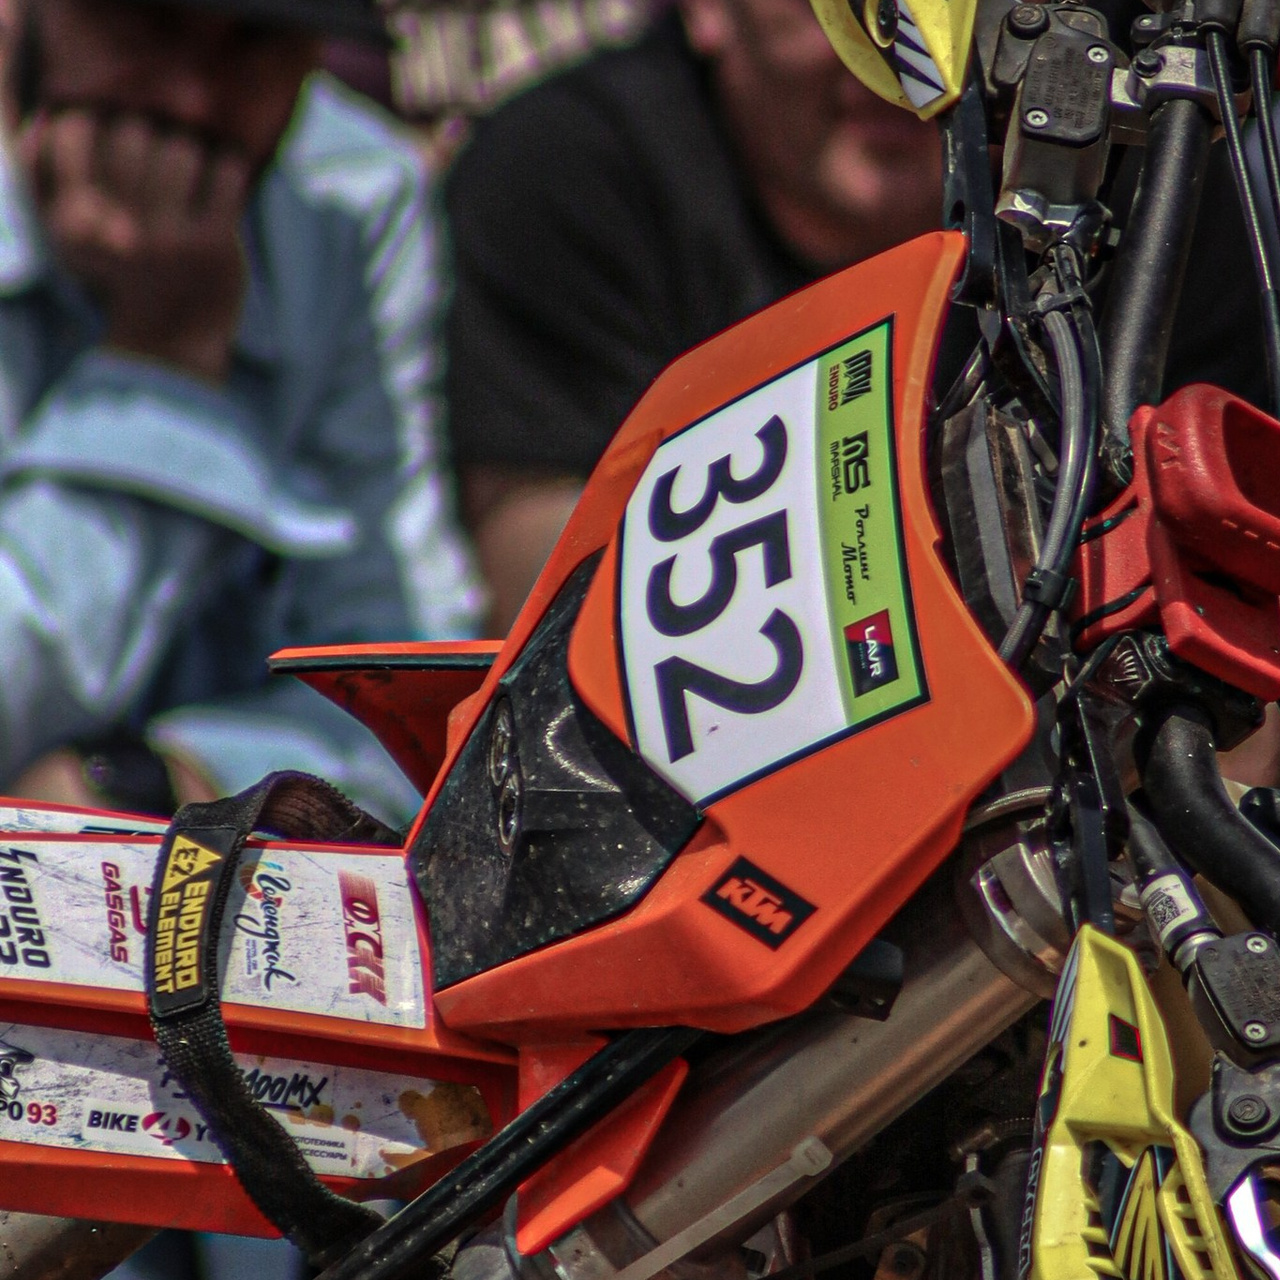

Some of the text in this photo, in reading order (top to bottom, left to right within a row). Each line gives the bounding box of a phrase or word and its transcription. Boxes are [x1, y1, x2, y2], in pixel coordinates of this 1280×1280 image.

[828, 363, 840, 411] ENDURO
[830, 441, 842, 501] MARSHAL
[646, 414, 803, 763] 352
[865, 625, 881, 677] LAVR
[101, 861, 128, 964] GASGAS
[716, 878, 792, 934] KTM
[155, 891, 180, 994] ELEMENT
[176, 880, 210, 990] ENDURO
[27, 1102, 57, 1125] 93
[87, 1110, 139, 1133] BIKE
[290, 1134, 345, 1150] ОТОТЕХНИКА
